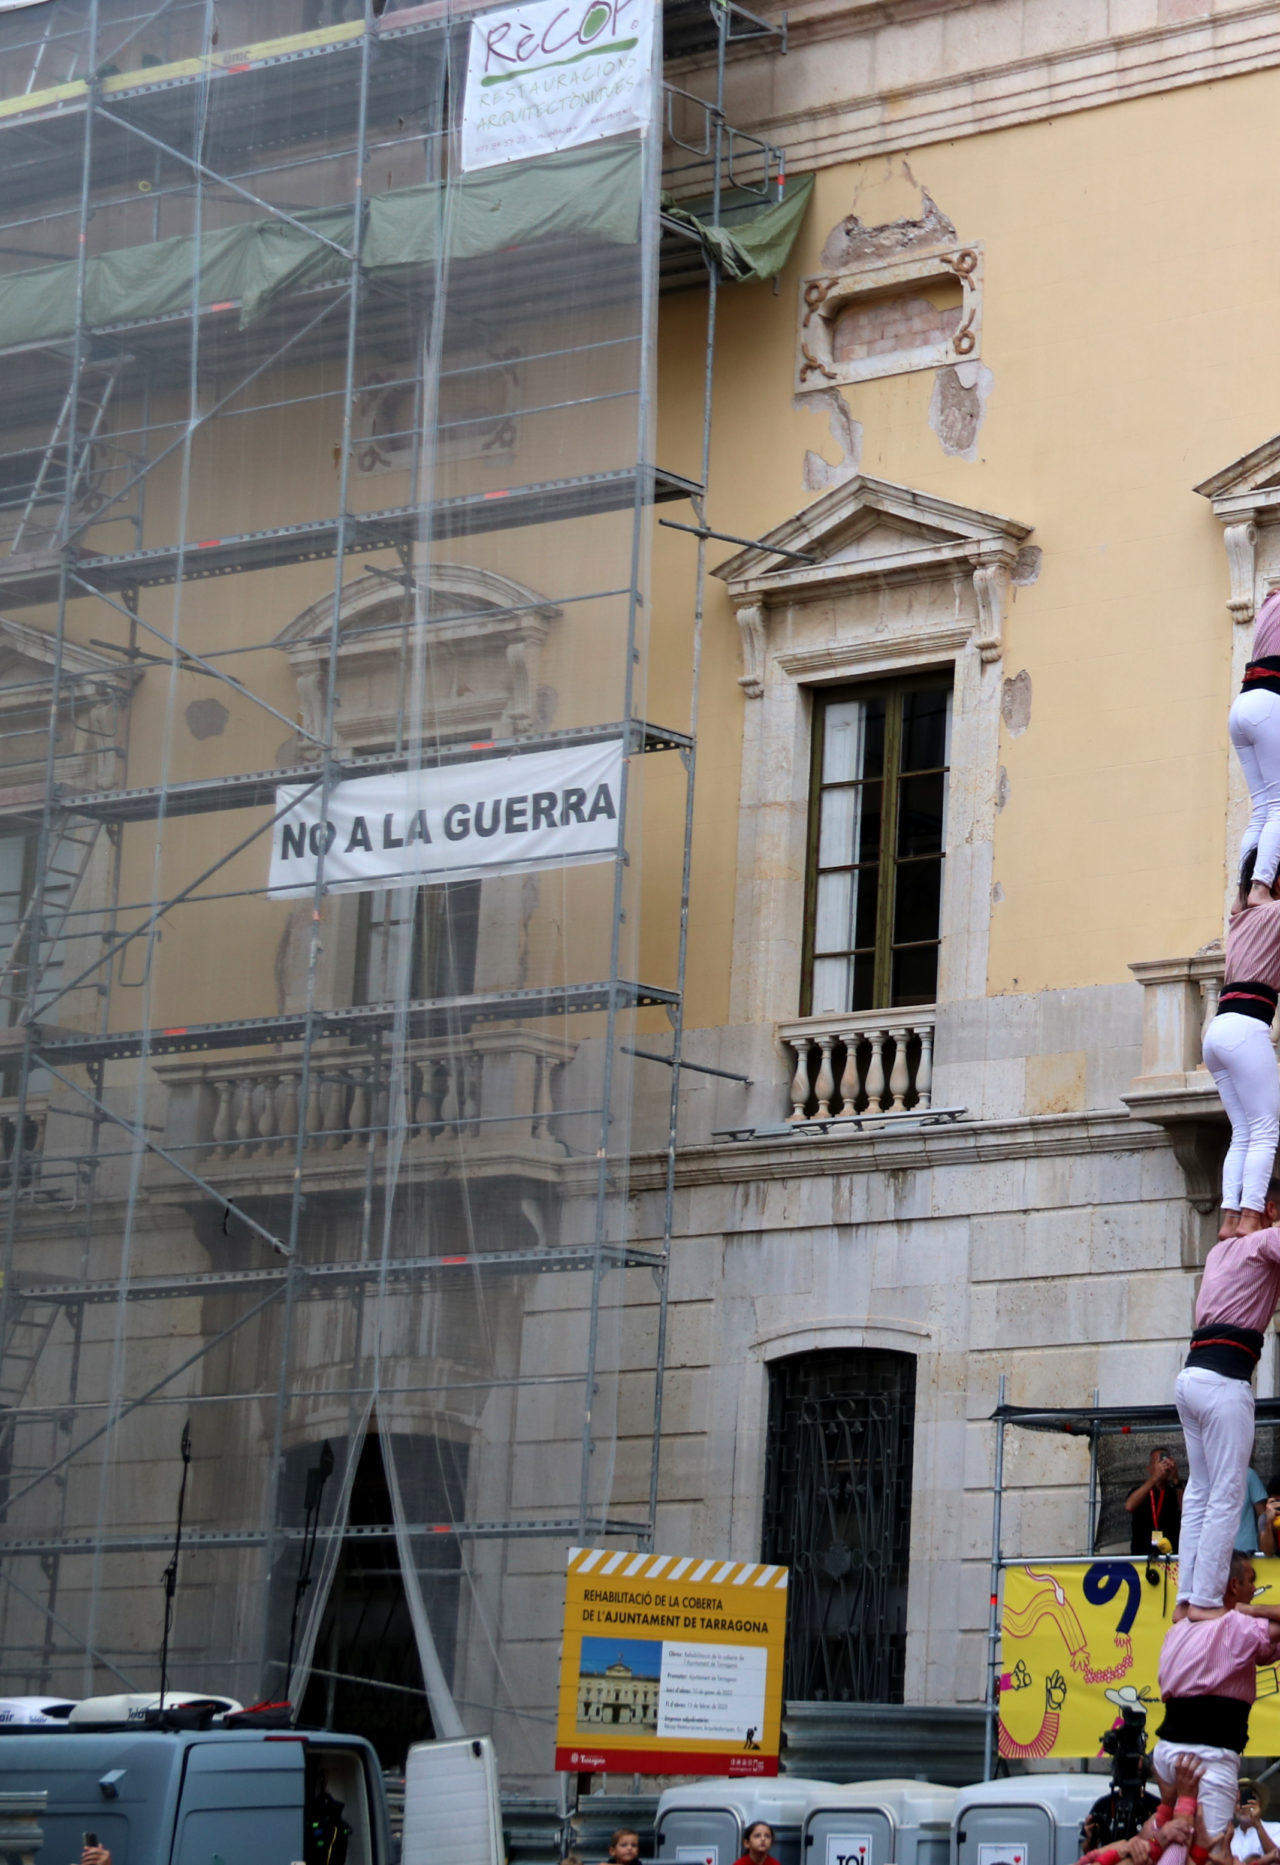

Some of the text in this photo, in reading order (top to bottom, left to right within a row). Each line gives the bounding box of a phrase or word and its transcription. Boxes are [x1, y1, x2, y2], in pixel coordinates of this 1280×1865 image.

[479, 56, 637, 108] RESTAURACIONS
[281, 783, 617, 860] NO A LA GUERRA
[583, 1589, 724, 1611] REHABILITACIÓ DE LA COBERTA
[582, 1609, 769, 1634] DE L'AJUNTAMENT DE TARRAGONA
